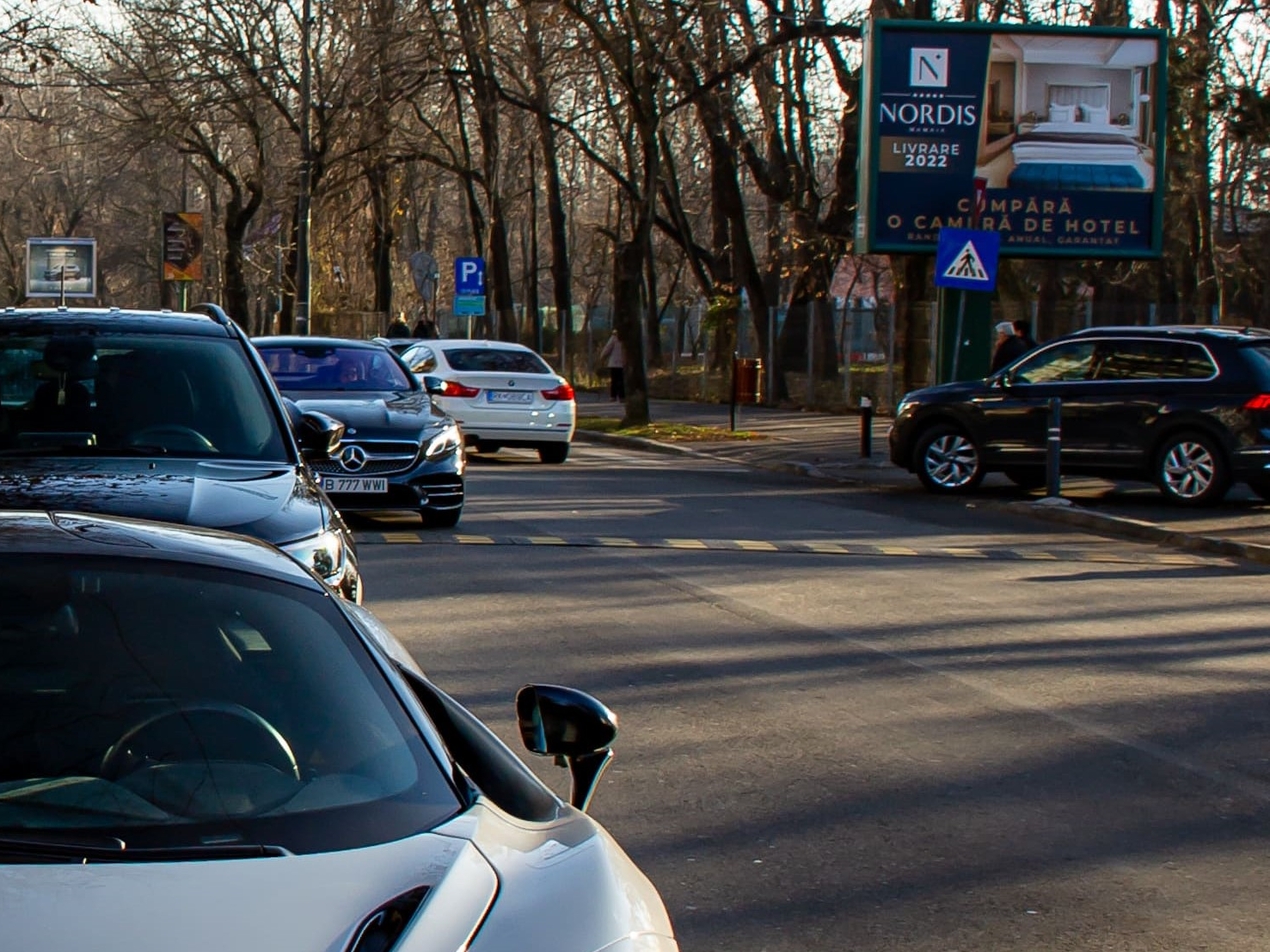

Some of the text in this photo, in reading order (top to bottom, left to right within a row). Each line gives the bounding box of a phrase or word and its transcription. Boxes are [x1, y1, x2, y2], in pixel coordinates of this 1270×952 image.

[879, 102, 976, 126] NORDIS
[893, 142, 960, 155] LIVRARE
[904, 154, 948, 168] 2022
[887, 214, 902, 229] O
[1023, 216, 1053, 233] DE
[1065, 218, 1140, 235] HOTEL
[462, 261, 478, 282] P
[326, 479, 385, 490] B 777 WWI
